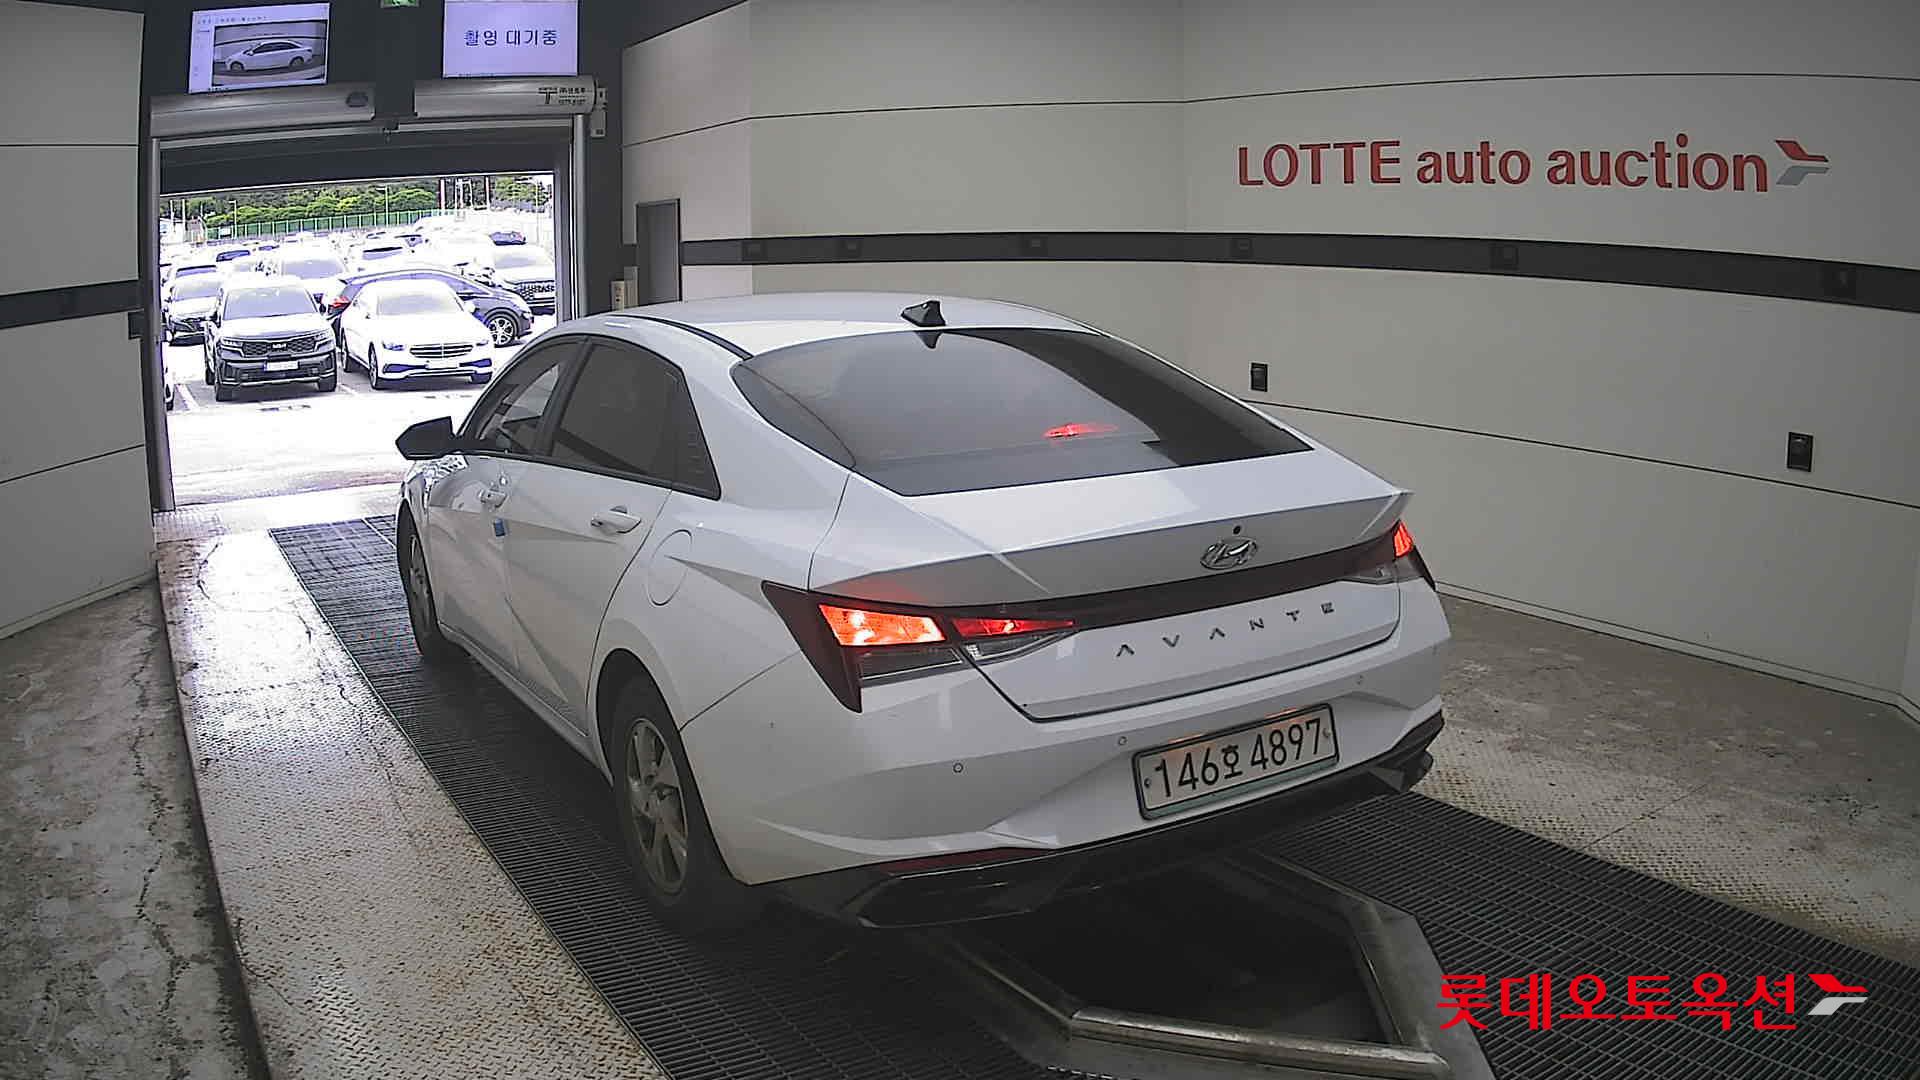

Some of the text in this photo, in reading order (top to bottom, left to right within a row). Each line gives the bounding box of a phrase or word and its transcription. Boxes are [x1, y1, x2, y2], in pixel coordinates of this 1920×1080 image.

[464, 30, 557, 46] 촬영 대기중
[1238, 134, 1767, 192] LOTTE auto auction
[1116, 602, 1335, 657] AVANTE
[1154, 718, 1321, 797] 146호 4897
